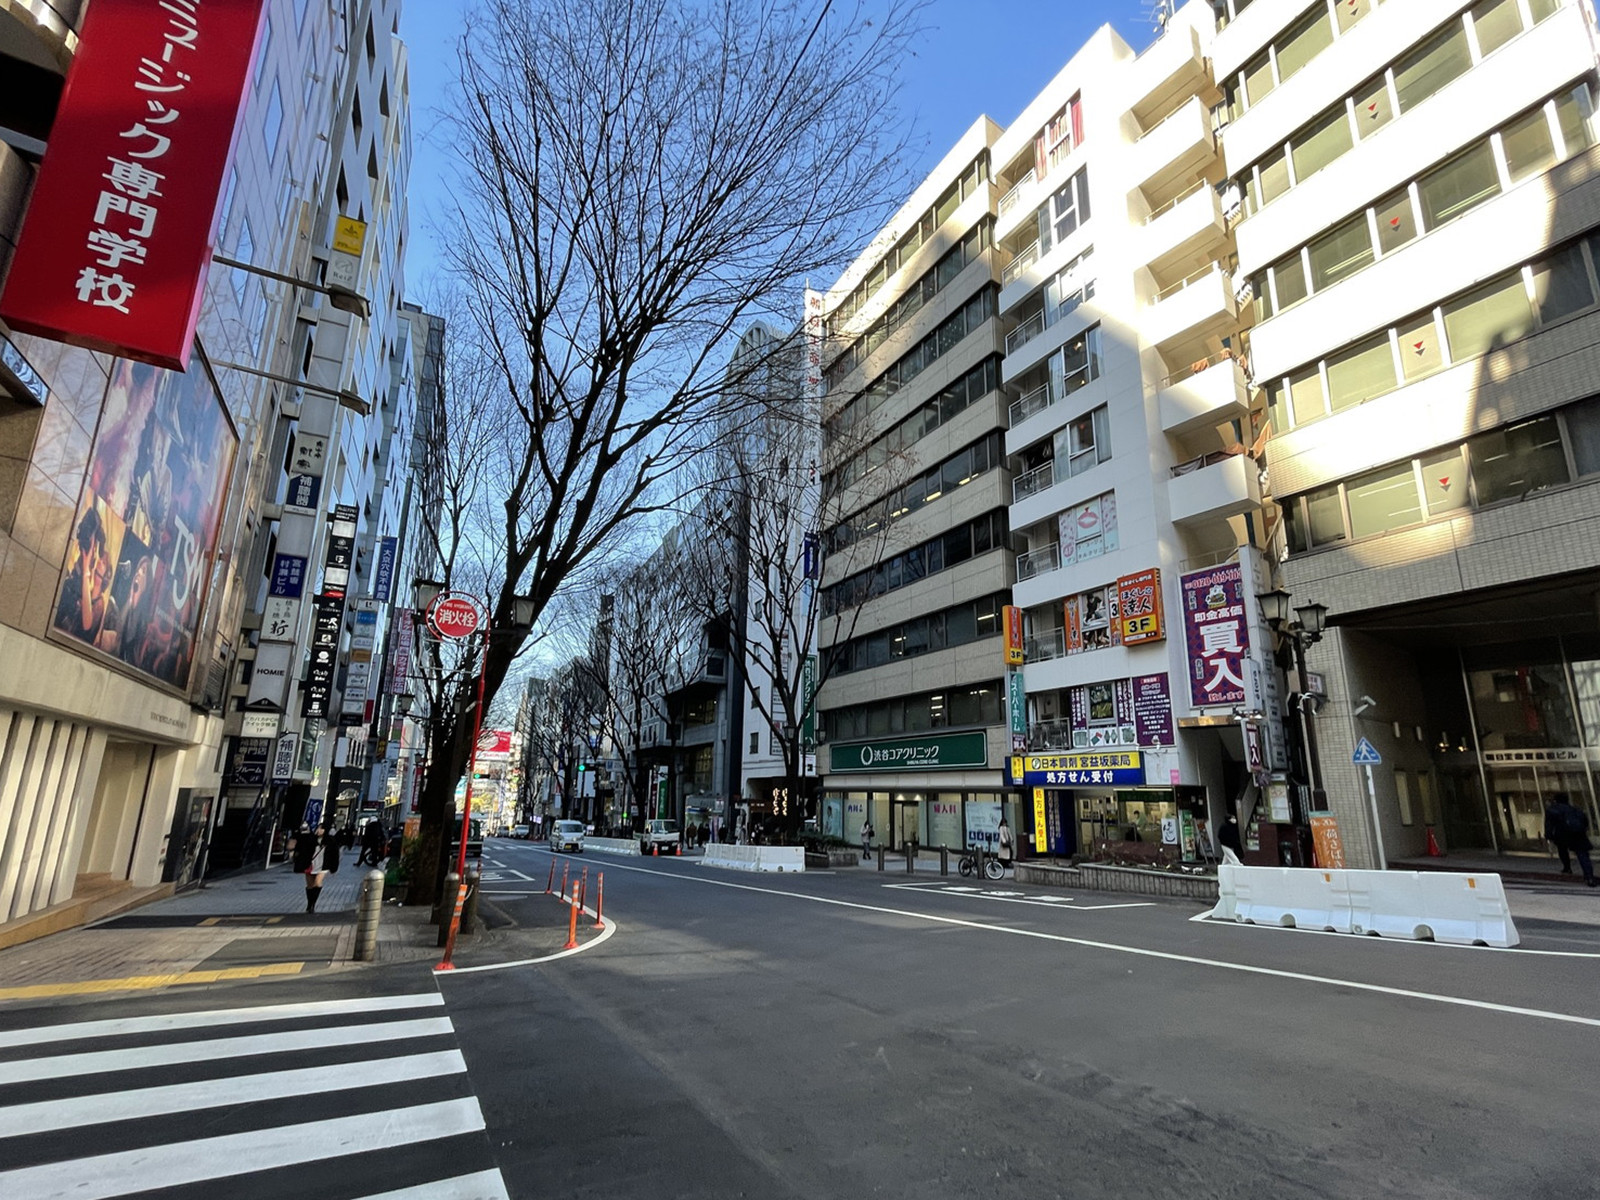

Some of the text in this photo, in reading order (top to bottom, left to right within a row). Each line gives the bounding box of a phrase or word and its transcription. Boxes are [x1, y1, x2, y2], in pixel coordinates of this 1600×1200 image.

[75, 0, 200, 314] ミュージック専門学校
[1122, 597, 1152, 617] 達人
[1194, 604, 1244, 622] 即金高価
[438, 608, 476, 627] 消火栓
[1129, 617, 1150, 633] 3F
[1010, 651, 1021, 659] 3F
[1199, 620, 1244, 692] 買入
[256, 668, 285, 677] HOMIE
[873, 745, 940, 762] 渋谷コアクリニック
[1249, 731, 1259, 765] 買入
[275, 739, 294, 776] 補聴器
[1041, 754, 1131, 769] 日本調剤 宮益坂薬局
[1046, 770, 1114, 784] 処方せん受付
[933, 804, 957, 814] 婦人科
[1035, 789, 1045, 849] 処方せん受付
